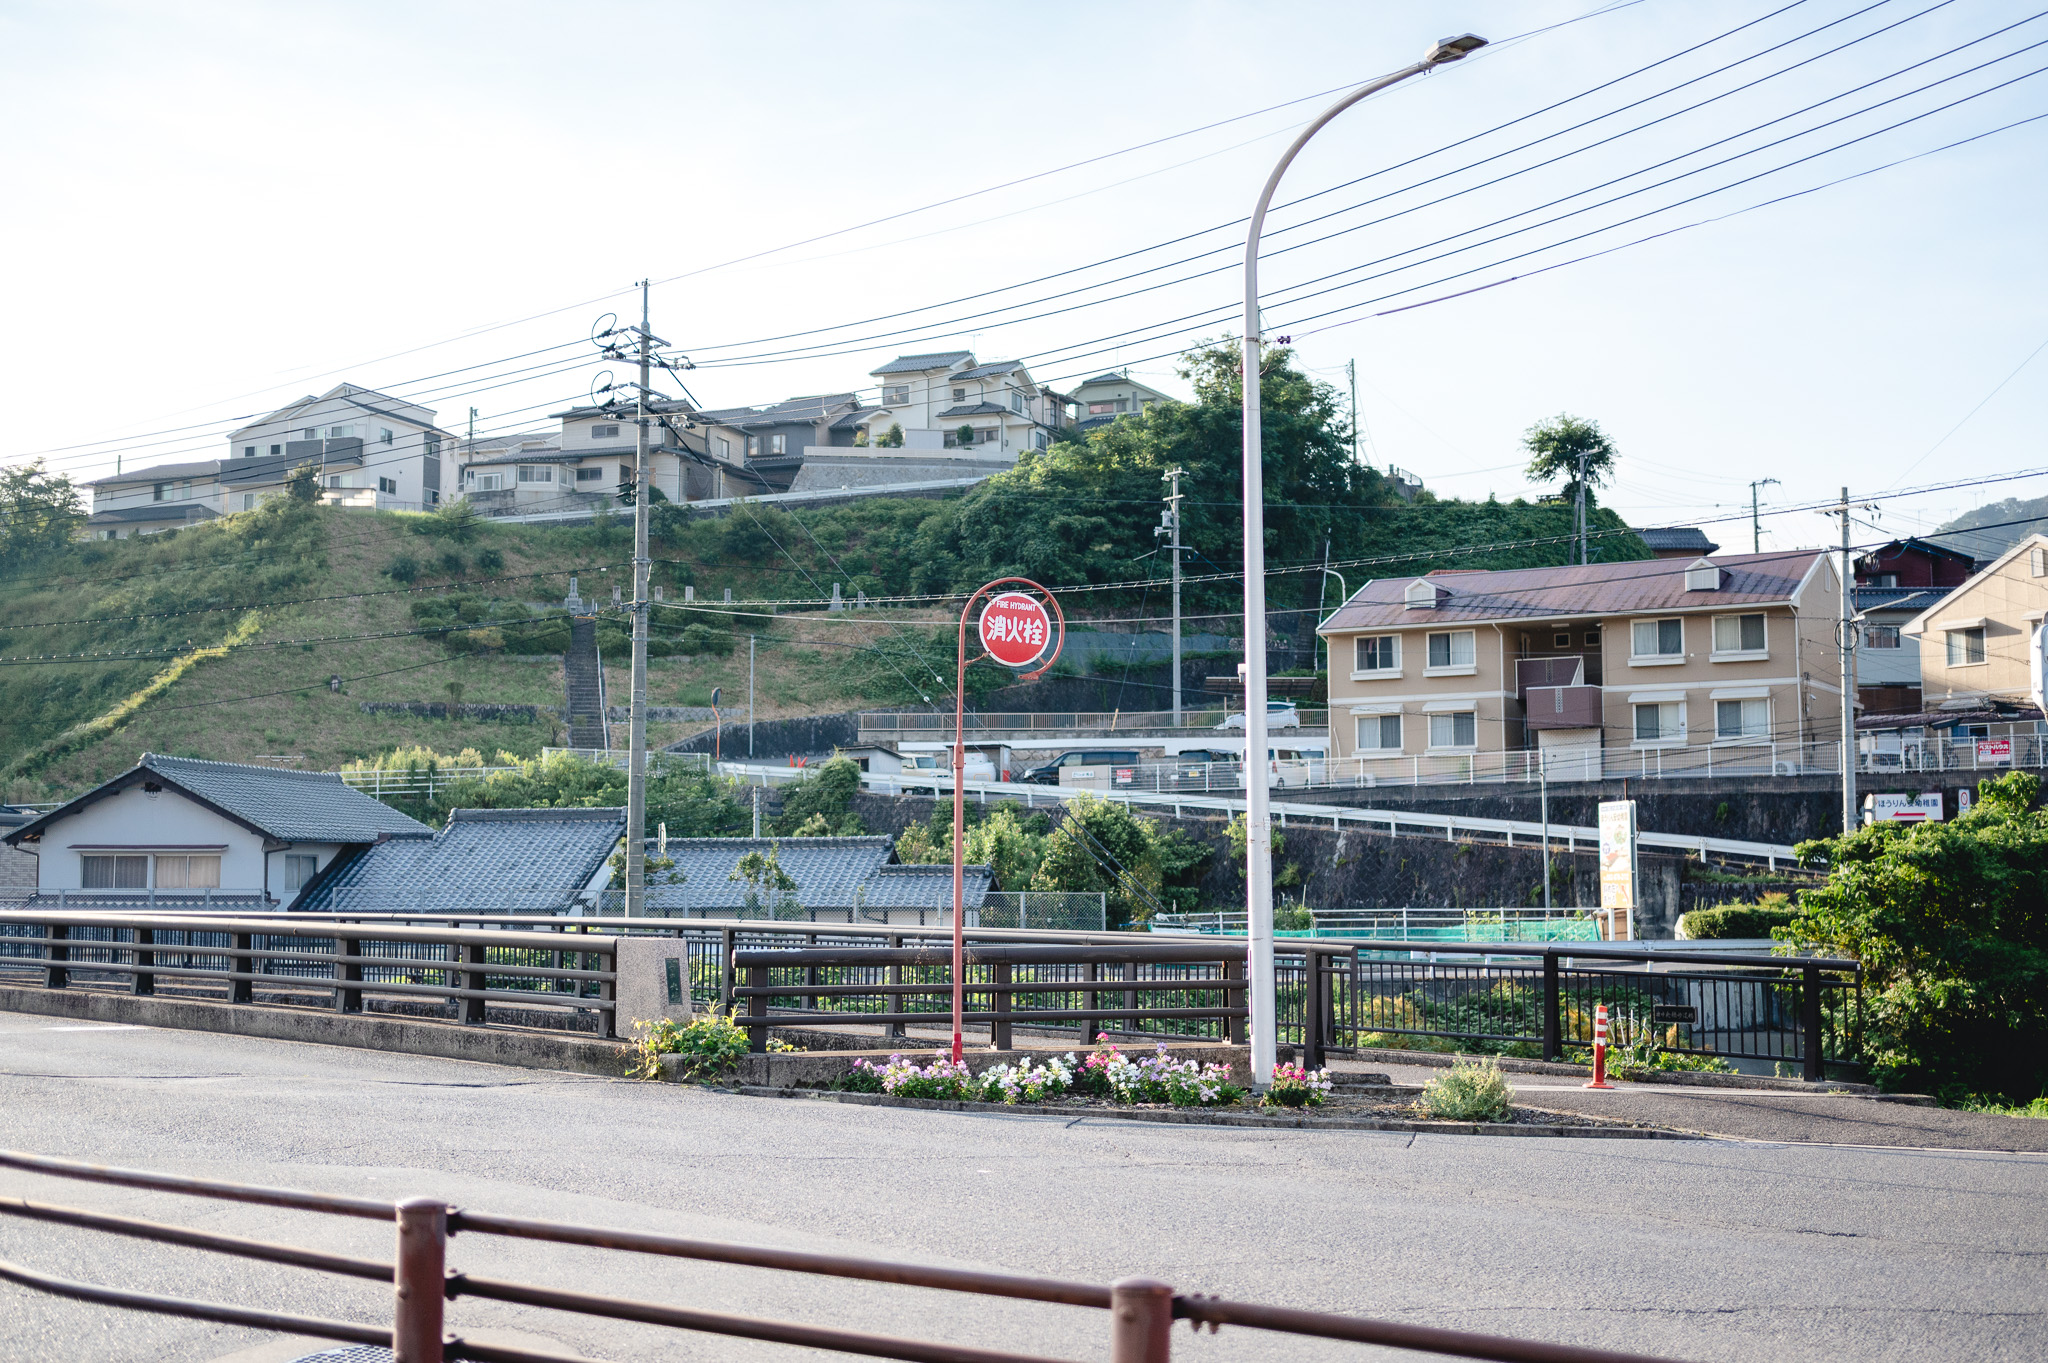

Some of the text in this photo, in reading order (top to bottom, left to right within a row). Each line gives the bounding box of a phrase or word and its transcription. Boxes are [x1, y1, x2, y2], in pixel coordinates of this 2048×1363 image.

[996, 600, 1037, 612] FIRE HYDRANT
[986, 614, 1044, 646] 消火栓
